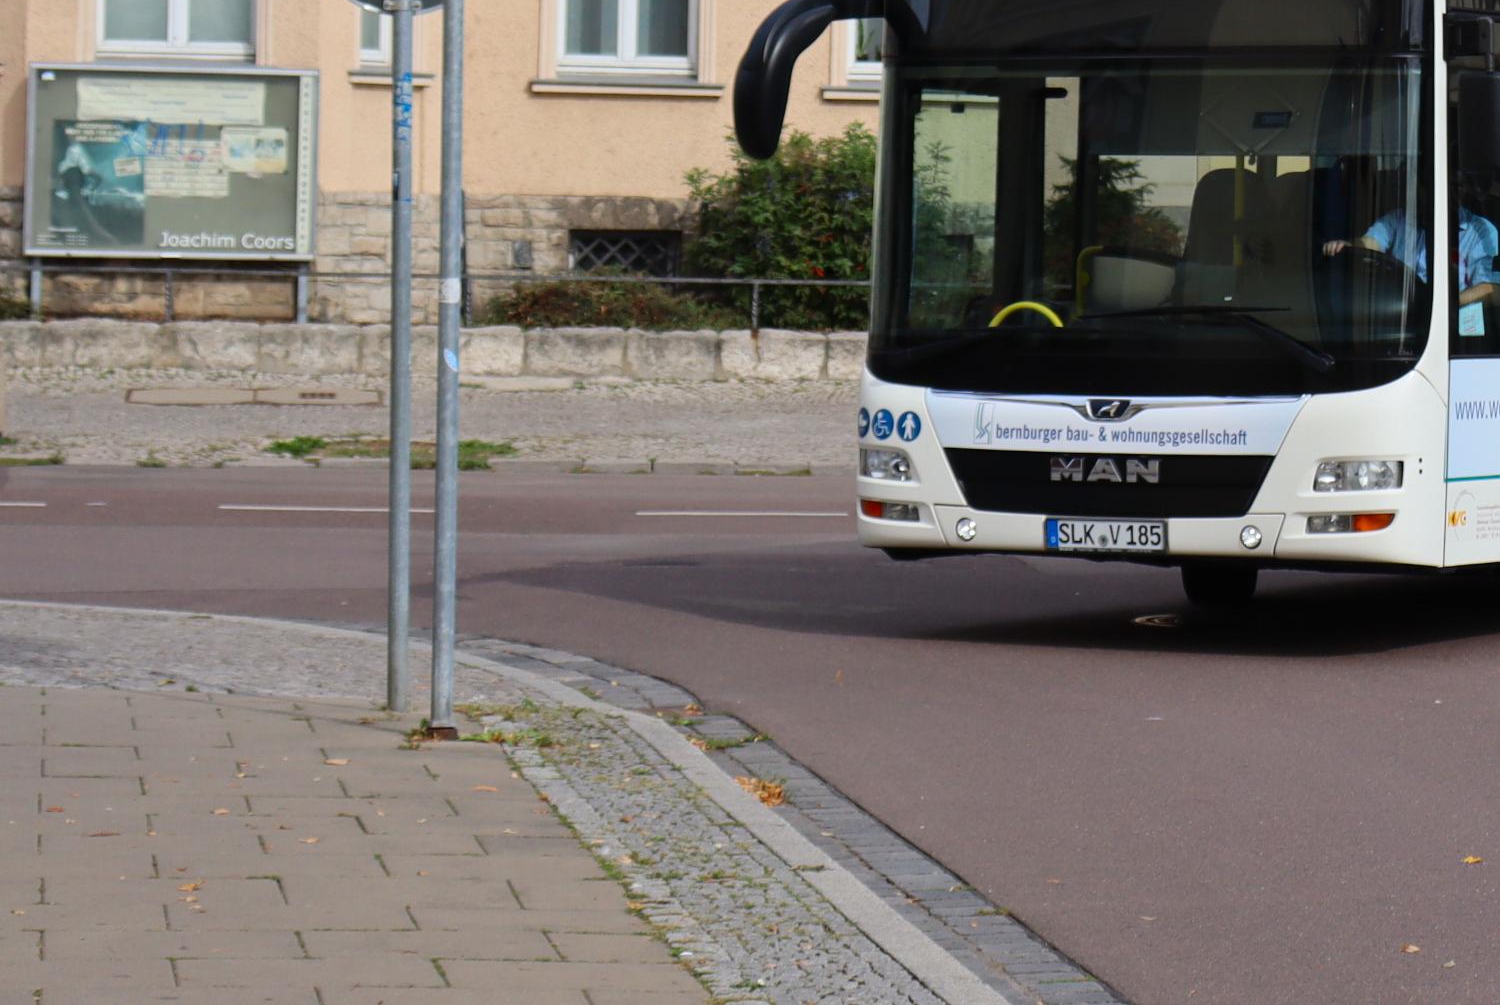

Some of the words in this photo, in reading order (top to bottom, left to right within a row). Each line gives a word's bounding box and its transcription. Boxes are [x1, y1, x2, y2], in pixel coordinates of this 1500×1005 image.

[159, 231, 236, 248] Joachim
[241, 233, 294, 250] Coors
[996, 424, 1063, 444] bernburger
[1066, 426, 1094, 442] bau-
[1098, 427, 1107, 442] &
[1111, 428, 1248, 447] wohnungsgesellschaft
[1050, 457, 1161, 484] MAN
[1059, 523, 1096, 545] SLK
[1109, 524, 1121, 545] V
[1126, 524, 1162, 546] 185
